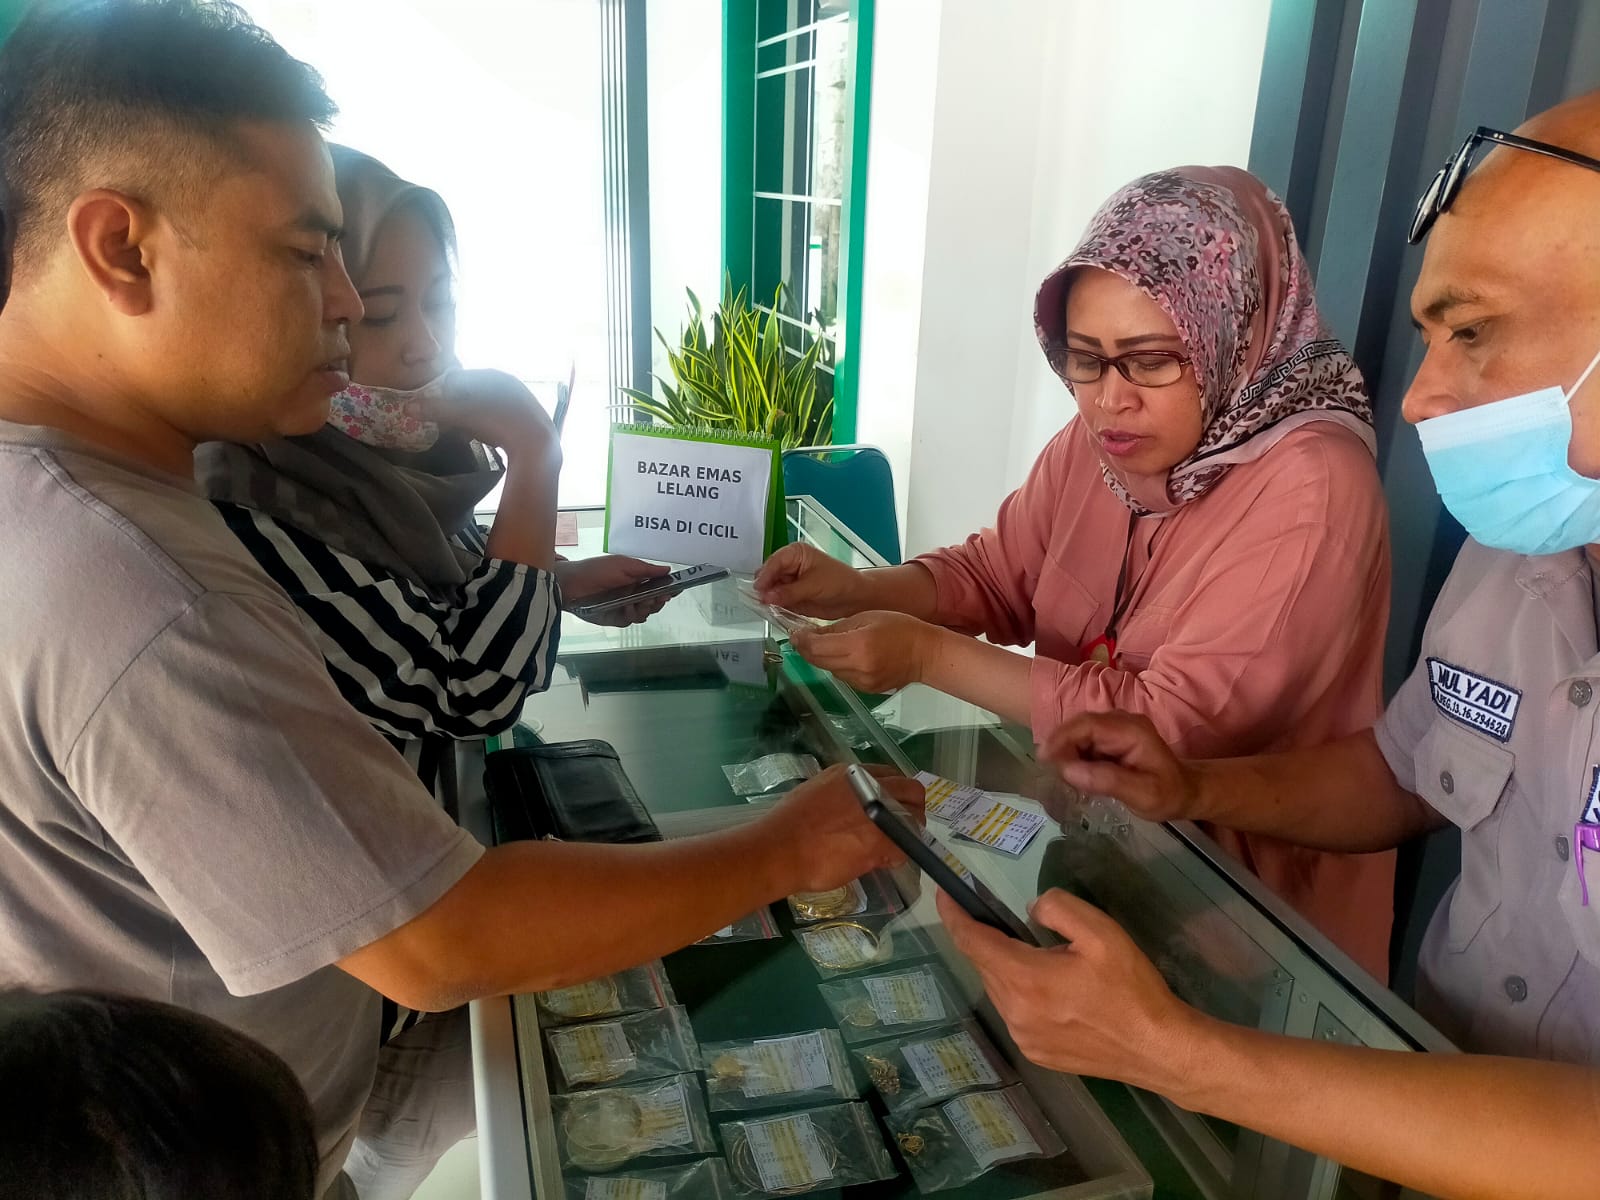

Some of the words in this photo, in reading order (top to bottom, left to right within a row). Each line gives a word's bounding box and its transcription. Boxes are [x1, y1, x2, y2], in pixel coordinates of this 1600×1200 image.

[637, 461, 690, 479] BAZAR
[696, 466, 742, 483] EMAS
[657, 481, 719, 499] LELANG
[634, 515, 671, 532] BISA
[676, 520, 692, 534] DI
[698, 523, 739, 539] CICIL
[1438, 665, 1512, 713] MULYADI
